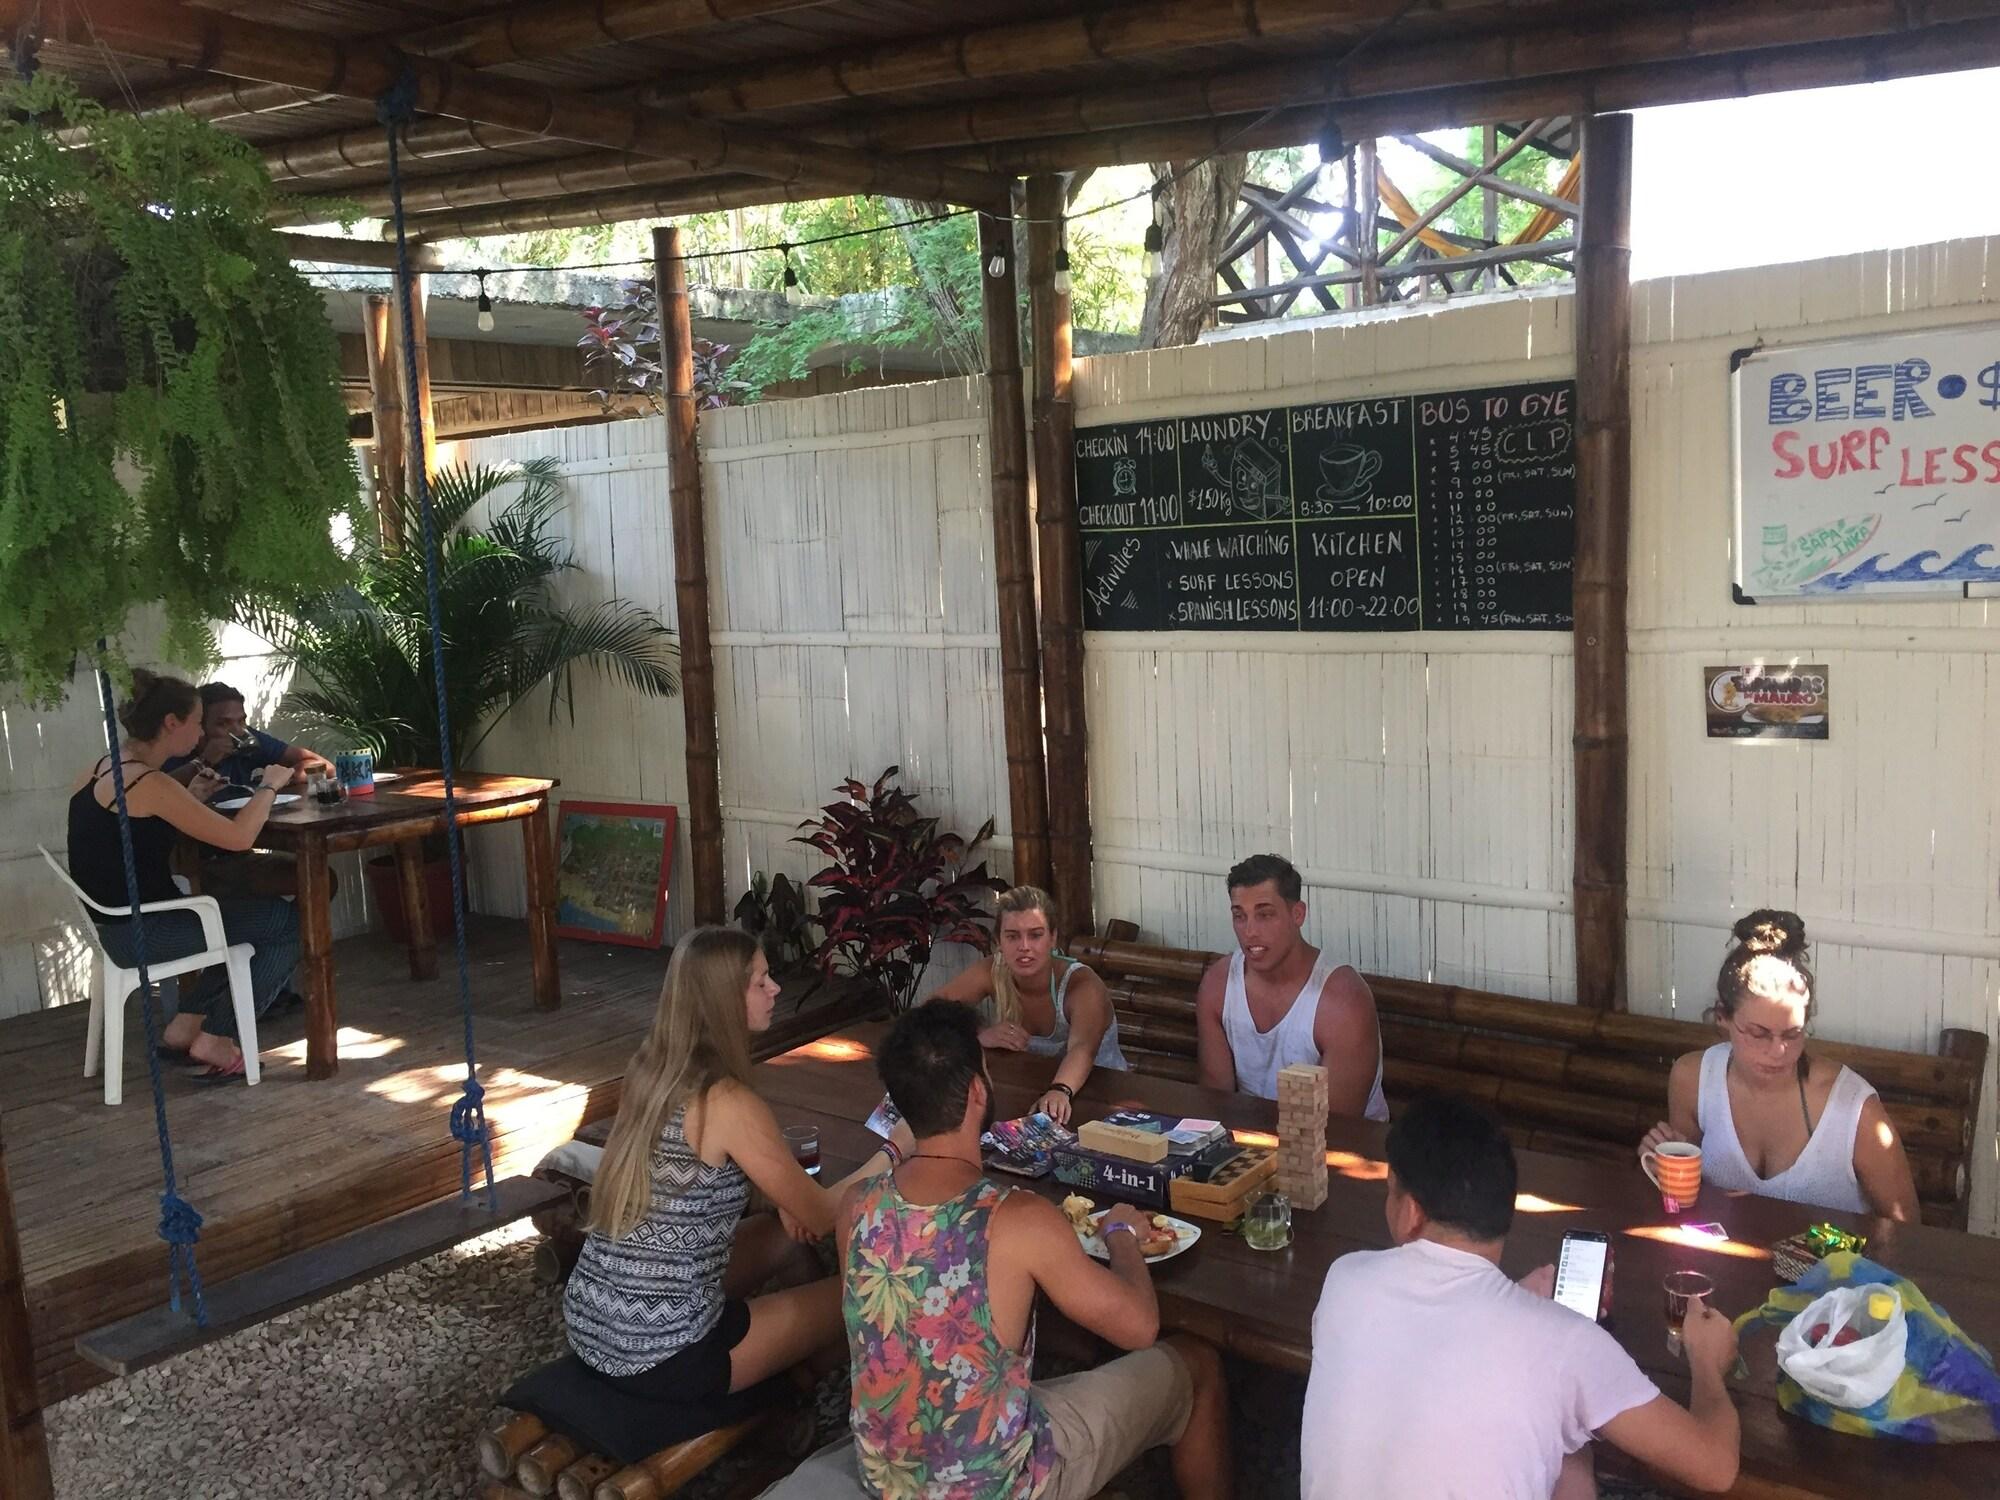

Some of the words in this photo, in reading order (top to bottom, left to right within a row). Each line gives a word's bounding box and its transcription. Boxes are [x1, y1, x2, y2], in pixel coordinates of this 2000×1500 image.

[1768, 357, 1935, 424] BEER
[1292, 400, 1406, 432] BREAKFAST
[1421, 398, 1470, 425] BUS
[1482, 397, 1508, 421] TO
[1521, 389, 1569, 416] GYE
[1136, 425, 1175, 455] 14:00
[1182, 411, 1272, 443] LAUNDRY
[1772, 426, 1890, 480] SURF
[1080, 502, 1136, 526] CHECKOUT
[1140, 494, 1178, 525] 11:00
[1300, 502, 1333, 516] 8:30
[1366, 494, 1412, 513] 10:00
[1171, 538, 1212, 560] WHALE
[1086, 537, 1141, 615] Activities
[1179, 573, 1217, 592] SURF
[1225, 570, 1294, 590] LESSONS
[1331, 567, 1385, 587] OPEN
[1236, 598, 1296, 622] LESSONS
[1308, 596, 1354, 618] 11:00
[1103, 1164, 1156, 1191] 4-in-1
